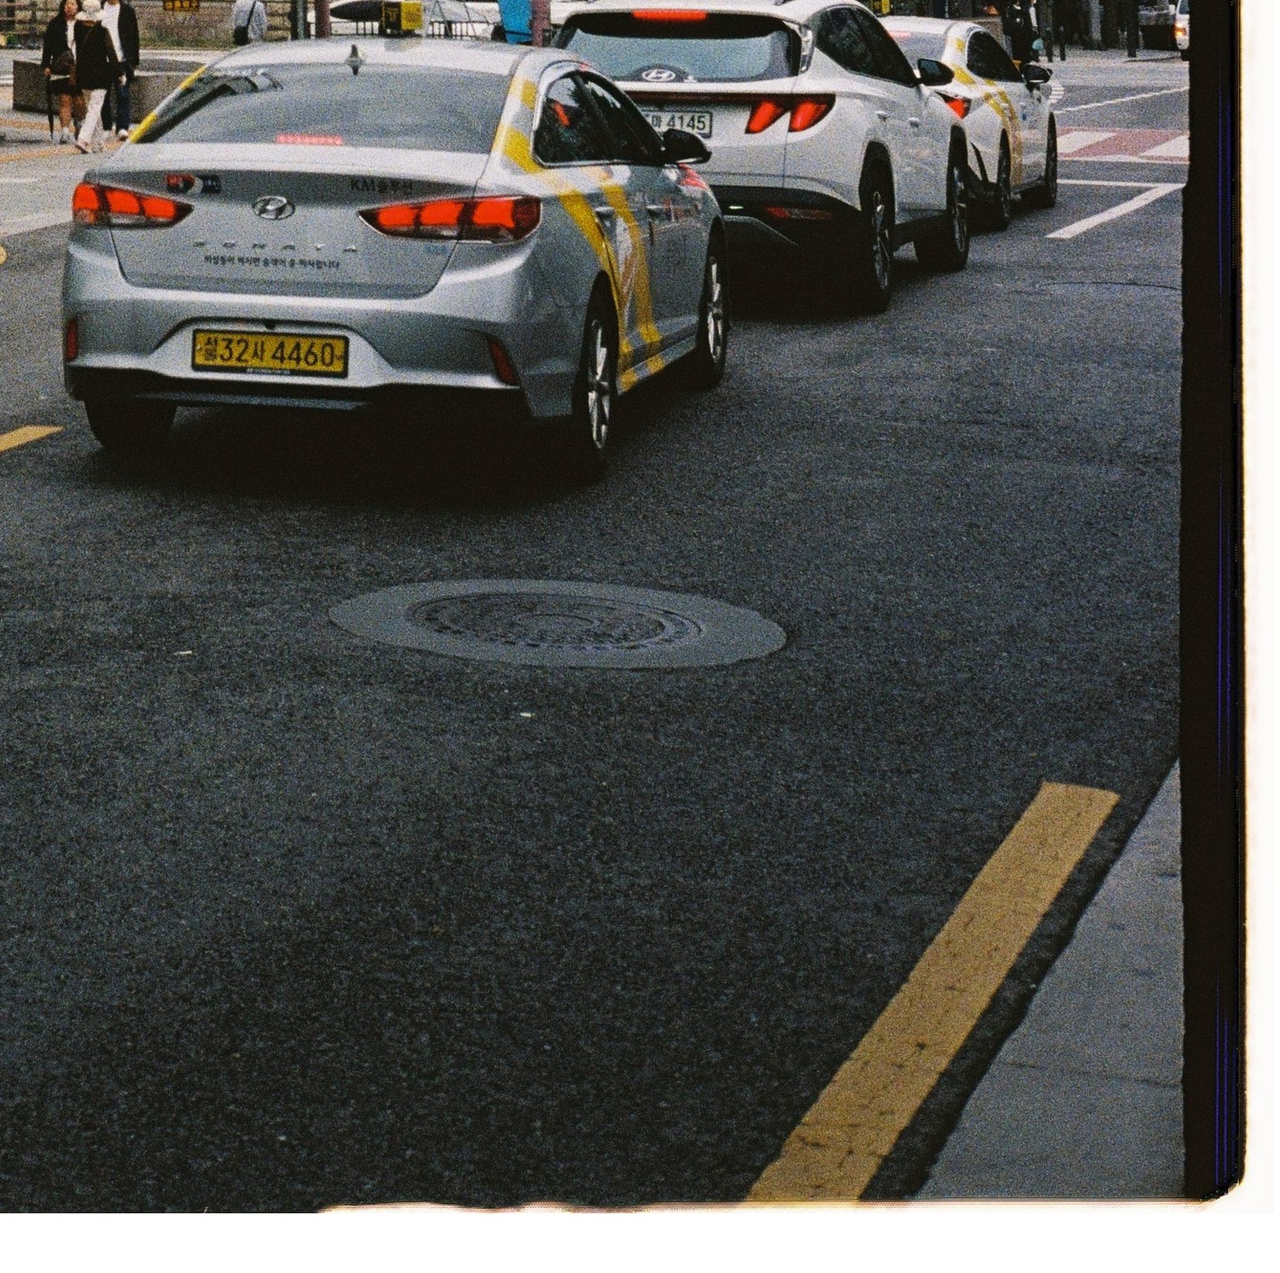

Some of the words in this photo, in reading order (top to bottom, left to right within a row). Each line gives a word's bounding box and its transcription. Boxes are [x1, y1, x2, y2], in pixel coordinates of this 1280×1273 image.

[667, 113, 706, 131] 4145
[220, 337, 265, 363] 32사
[272, 339, 335, 367] 4460
